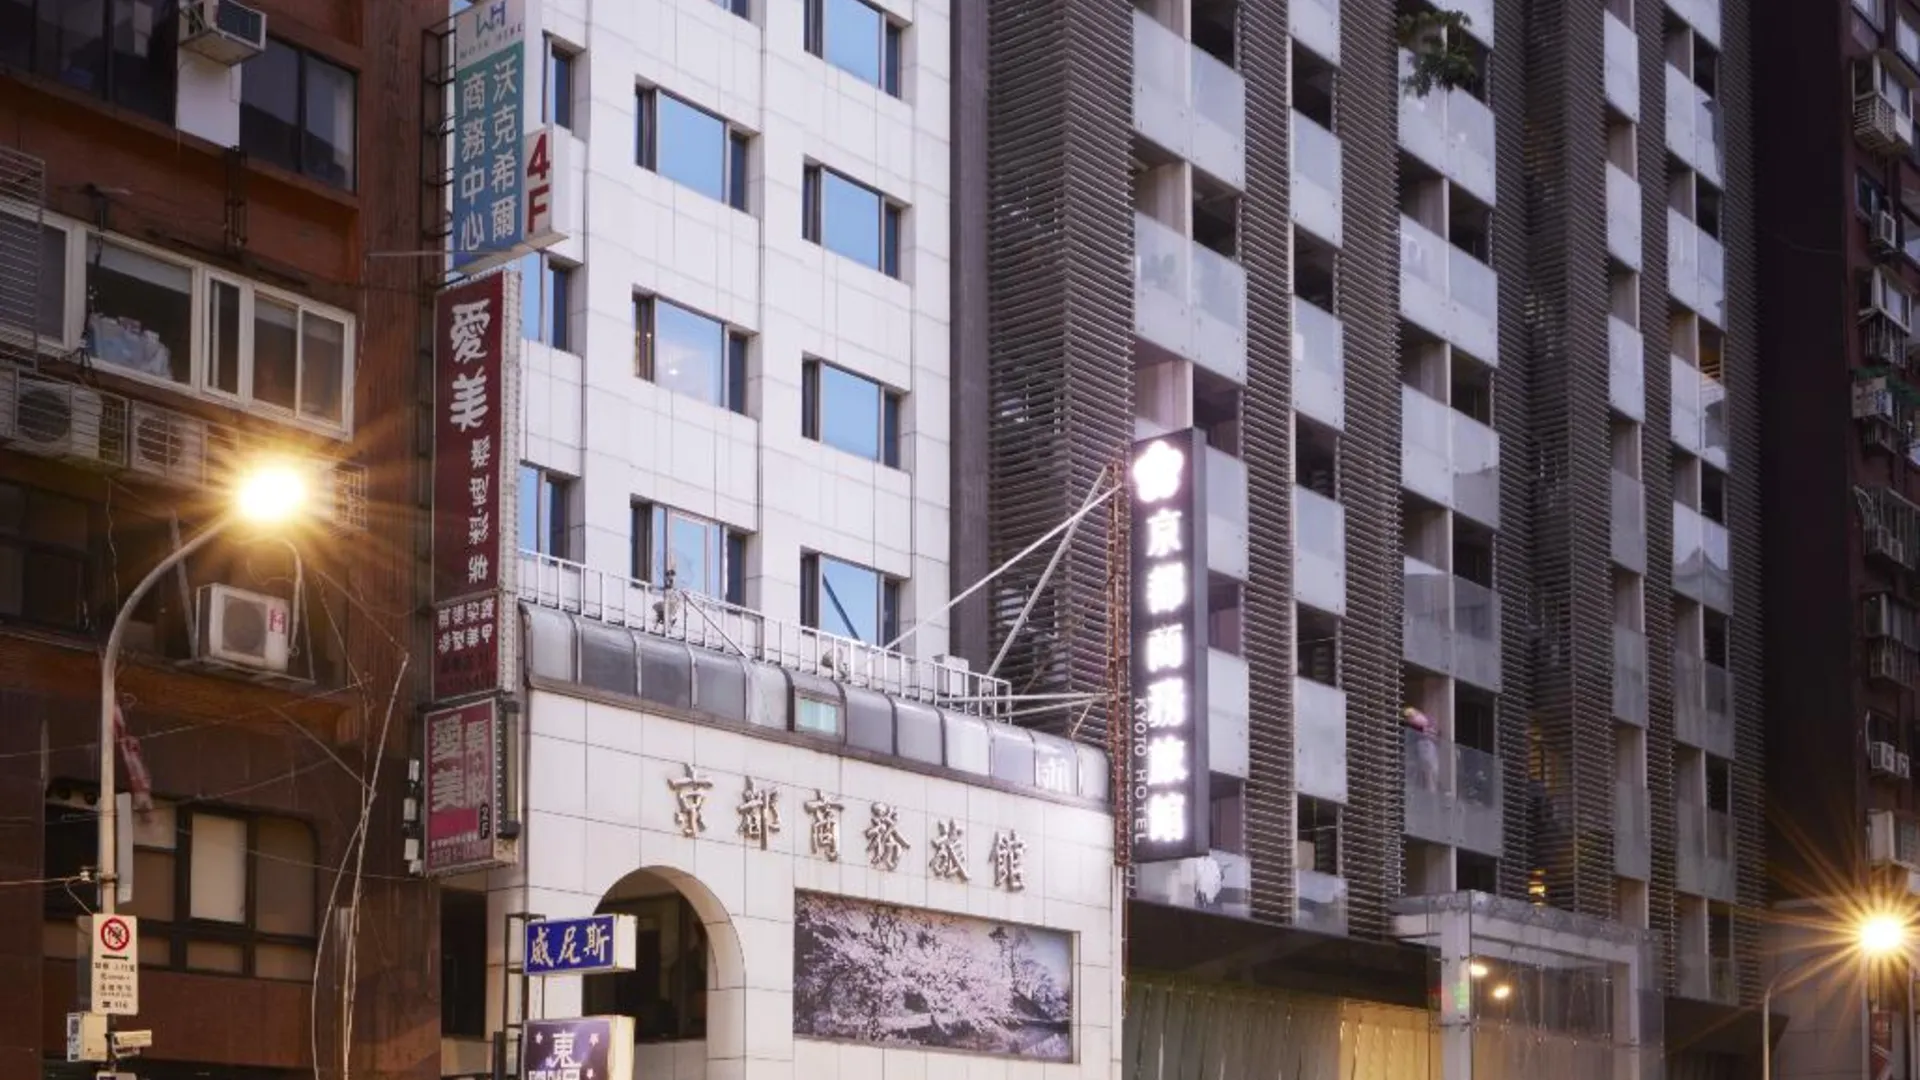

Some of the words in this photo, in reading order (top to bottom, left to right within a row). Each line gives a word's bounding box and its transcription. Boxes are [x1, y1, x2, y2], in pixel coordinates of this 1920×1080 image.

[460, 72, 487, 252] 商務中心
[491, 53, 518, 244] 沃克希爾
[526, 132, 551, 235] 4F
[449, 298, 491, 432] 愛美
[431, 713, 465, 813] 愛美
[1134, 696, 1148, 757] KYOTO
[667, 762, 1028, 893] 京都商務旅館
[1134, 768, 1148, 845] HOTEL
[530, 922, 612, 968] 威尼斯
[548, 1029, 582, 1068] 東
